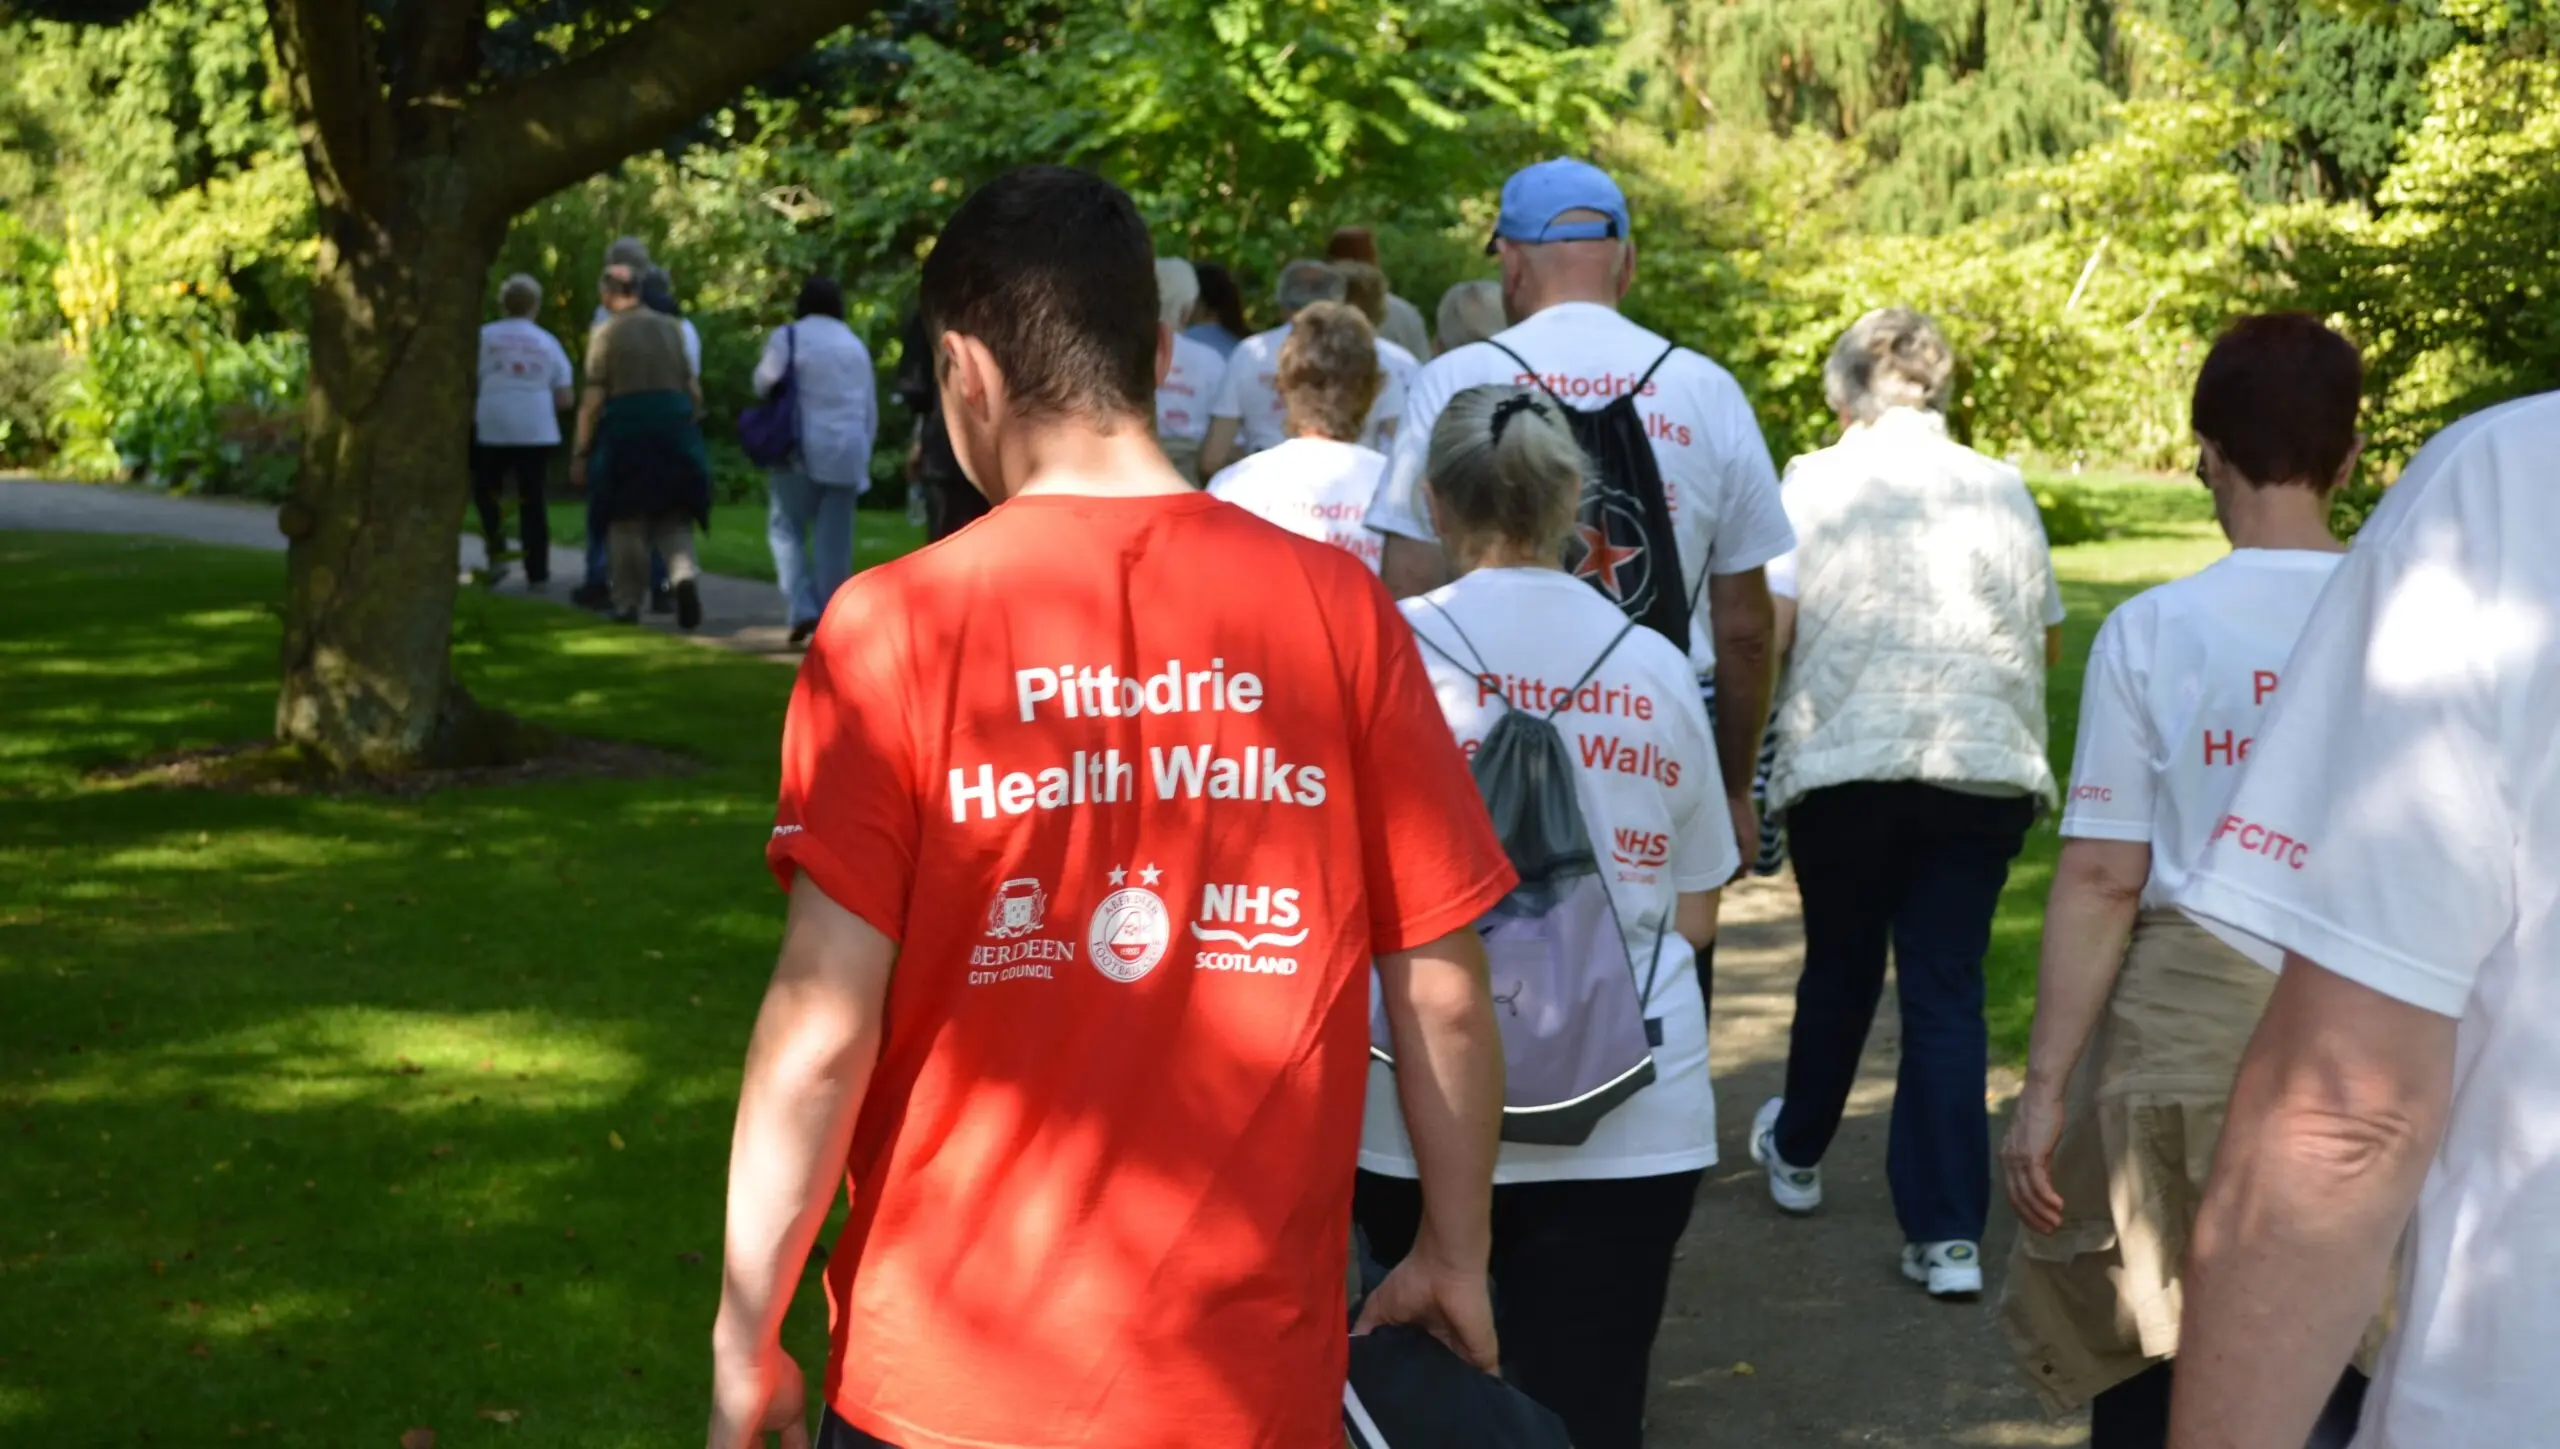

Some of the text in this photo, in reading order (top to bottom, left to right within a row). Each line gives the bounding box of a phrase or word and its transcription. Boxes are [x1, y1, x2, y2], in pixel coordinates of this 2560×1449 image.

[1648, 413, 1691, 447] lks
[1016, 658, 1263, 722] Pittodrie
[1477, 673, 1654, 720] Pittodrie
[948, 744, 1327, 823] Health Walks
[2209, 814, 2308, 870] FCITC
[1201, 883, 1300, 928] NHS
[968, 964, 1054, 985] CITY COUNCIL
[969, 939, 1076, 966] BERDEEN
[1194, 951, 1298, 976] SCOTLAND
